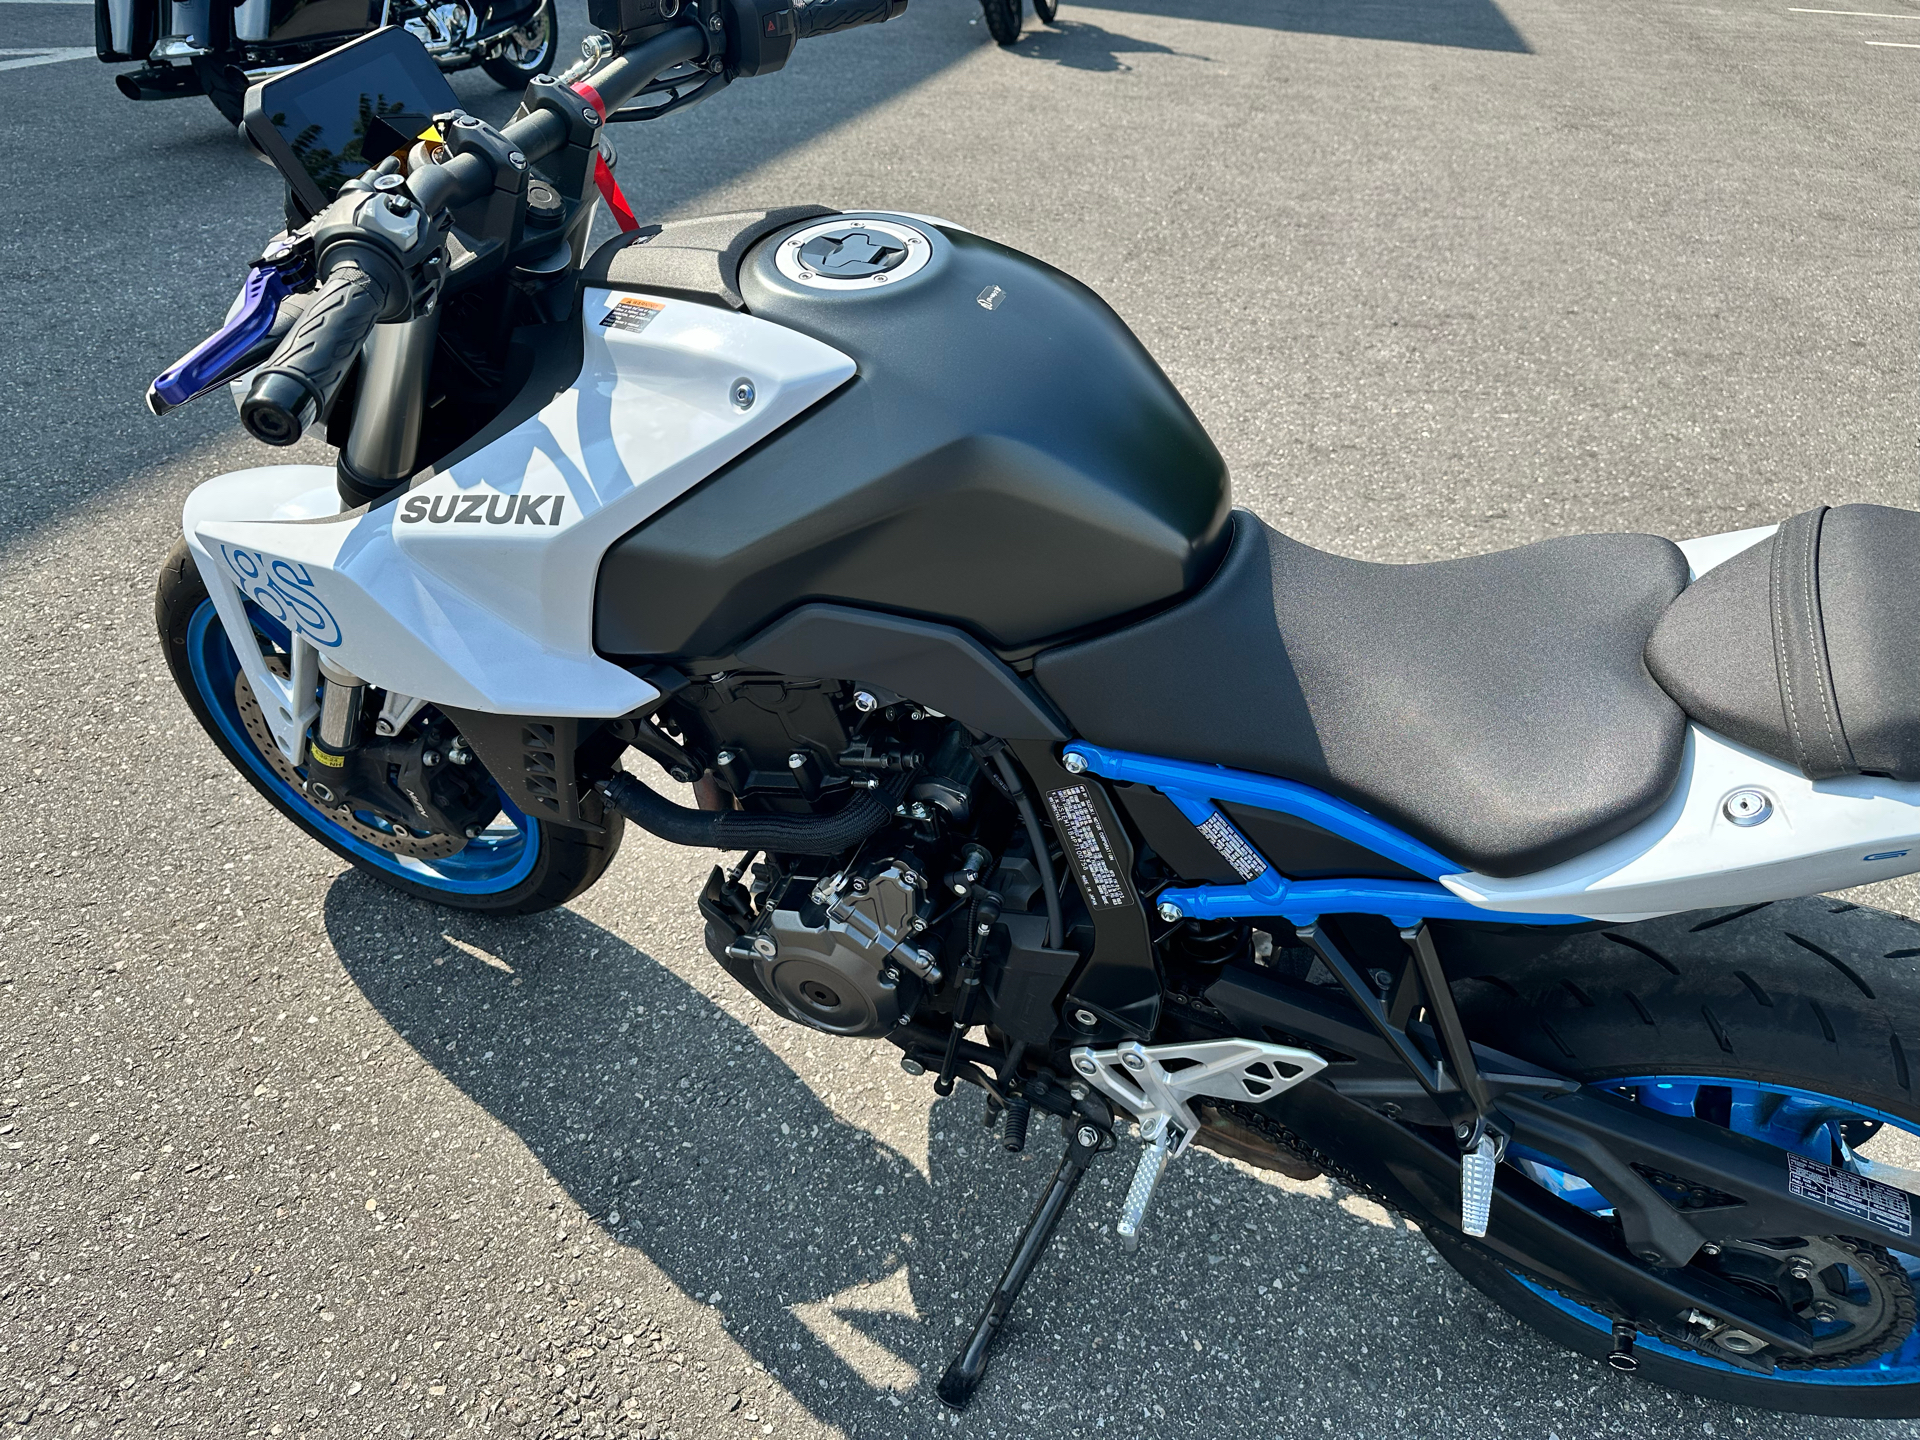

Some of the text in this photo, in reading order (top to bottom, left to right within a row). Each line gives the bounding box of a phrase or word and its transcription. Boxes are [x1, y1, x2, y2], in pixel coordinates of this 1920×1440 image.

[400, 495, 565, 526] SUZUKI
[1084, 799, 1095, 815] SUZUKI
[1091, 816, 1101, 831] MOTOR
[1098, 831, 1114, 861] CORPORATION
